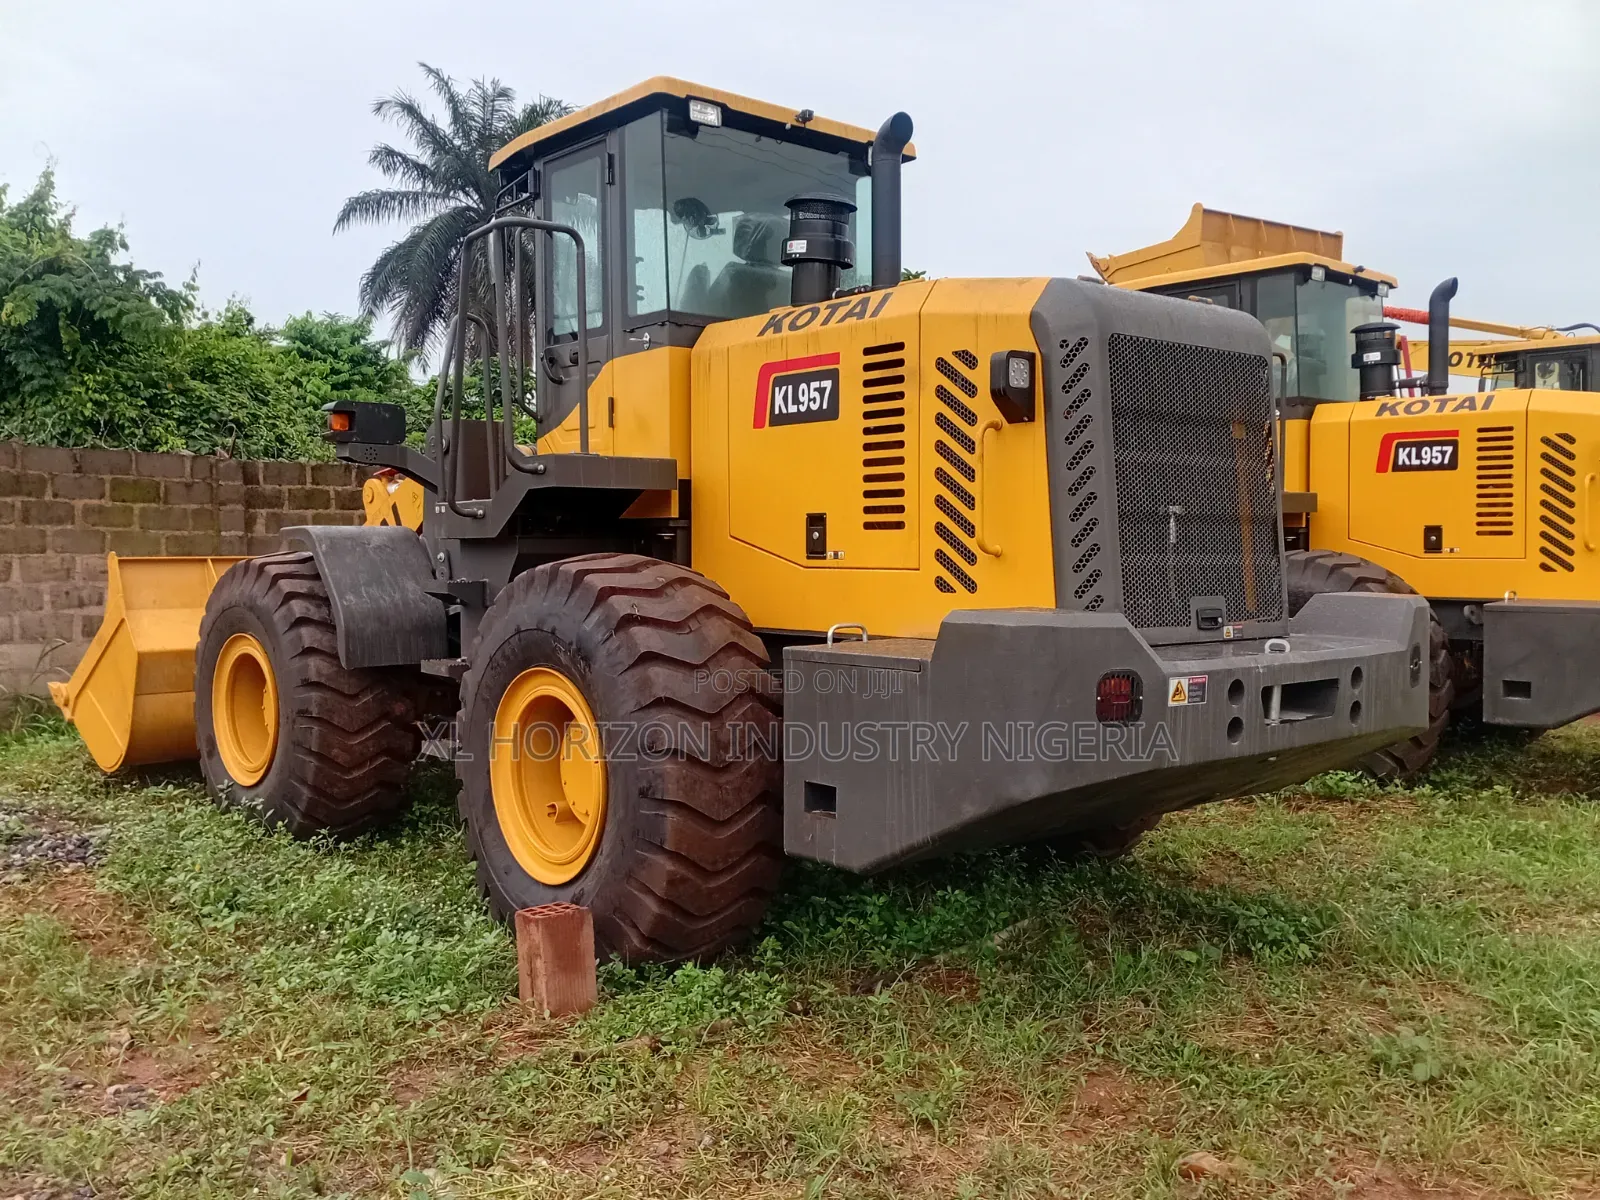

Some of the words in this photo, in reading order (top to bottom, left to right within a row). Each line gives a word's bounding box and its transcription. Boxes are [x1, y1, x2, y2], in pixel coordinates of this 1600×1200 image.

[757, 292, 893, 337] KOTAI
[774, 380, 833, 415] KL957
[1375, 395, 1496, 417] KOTAI
[1398, 446, 1453, 466] KL957
